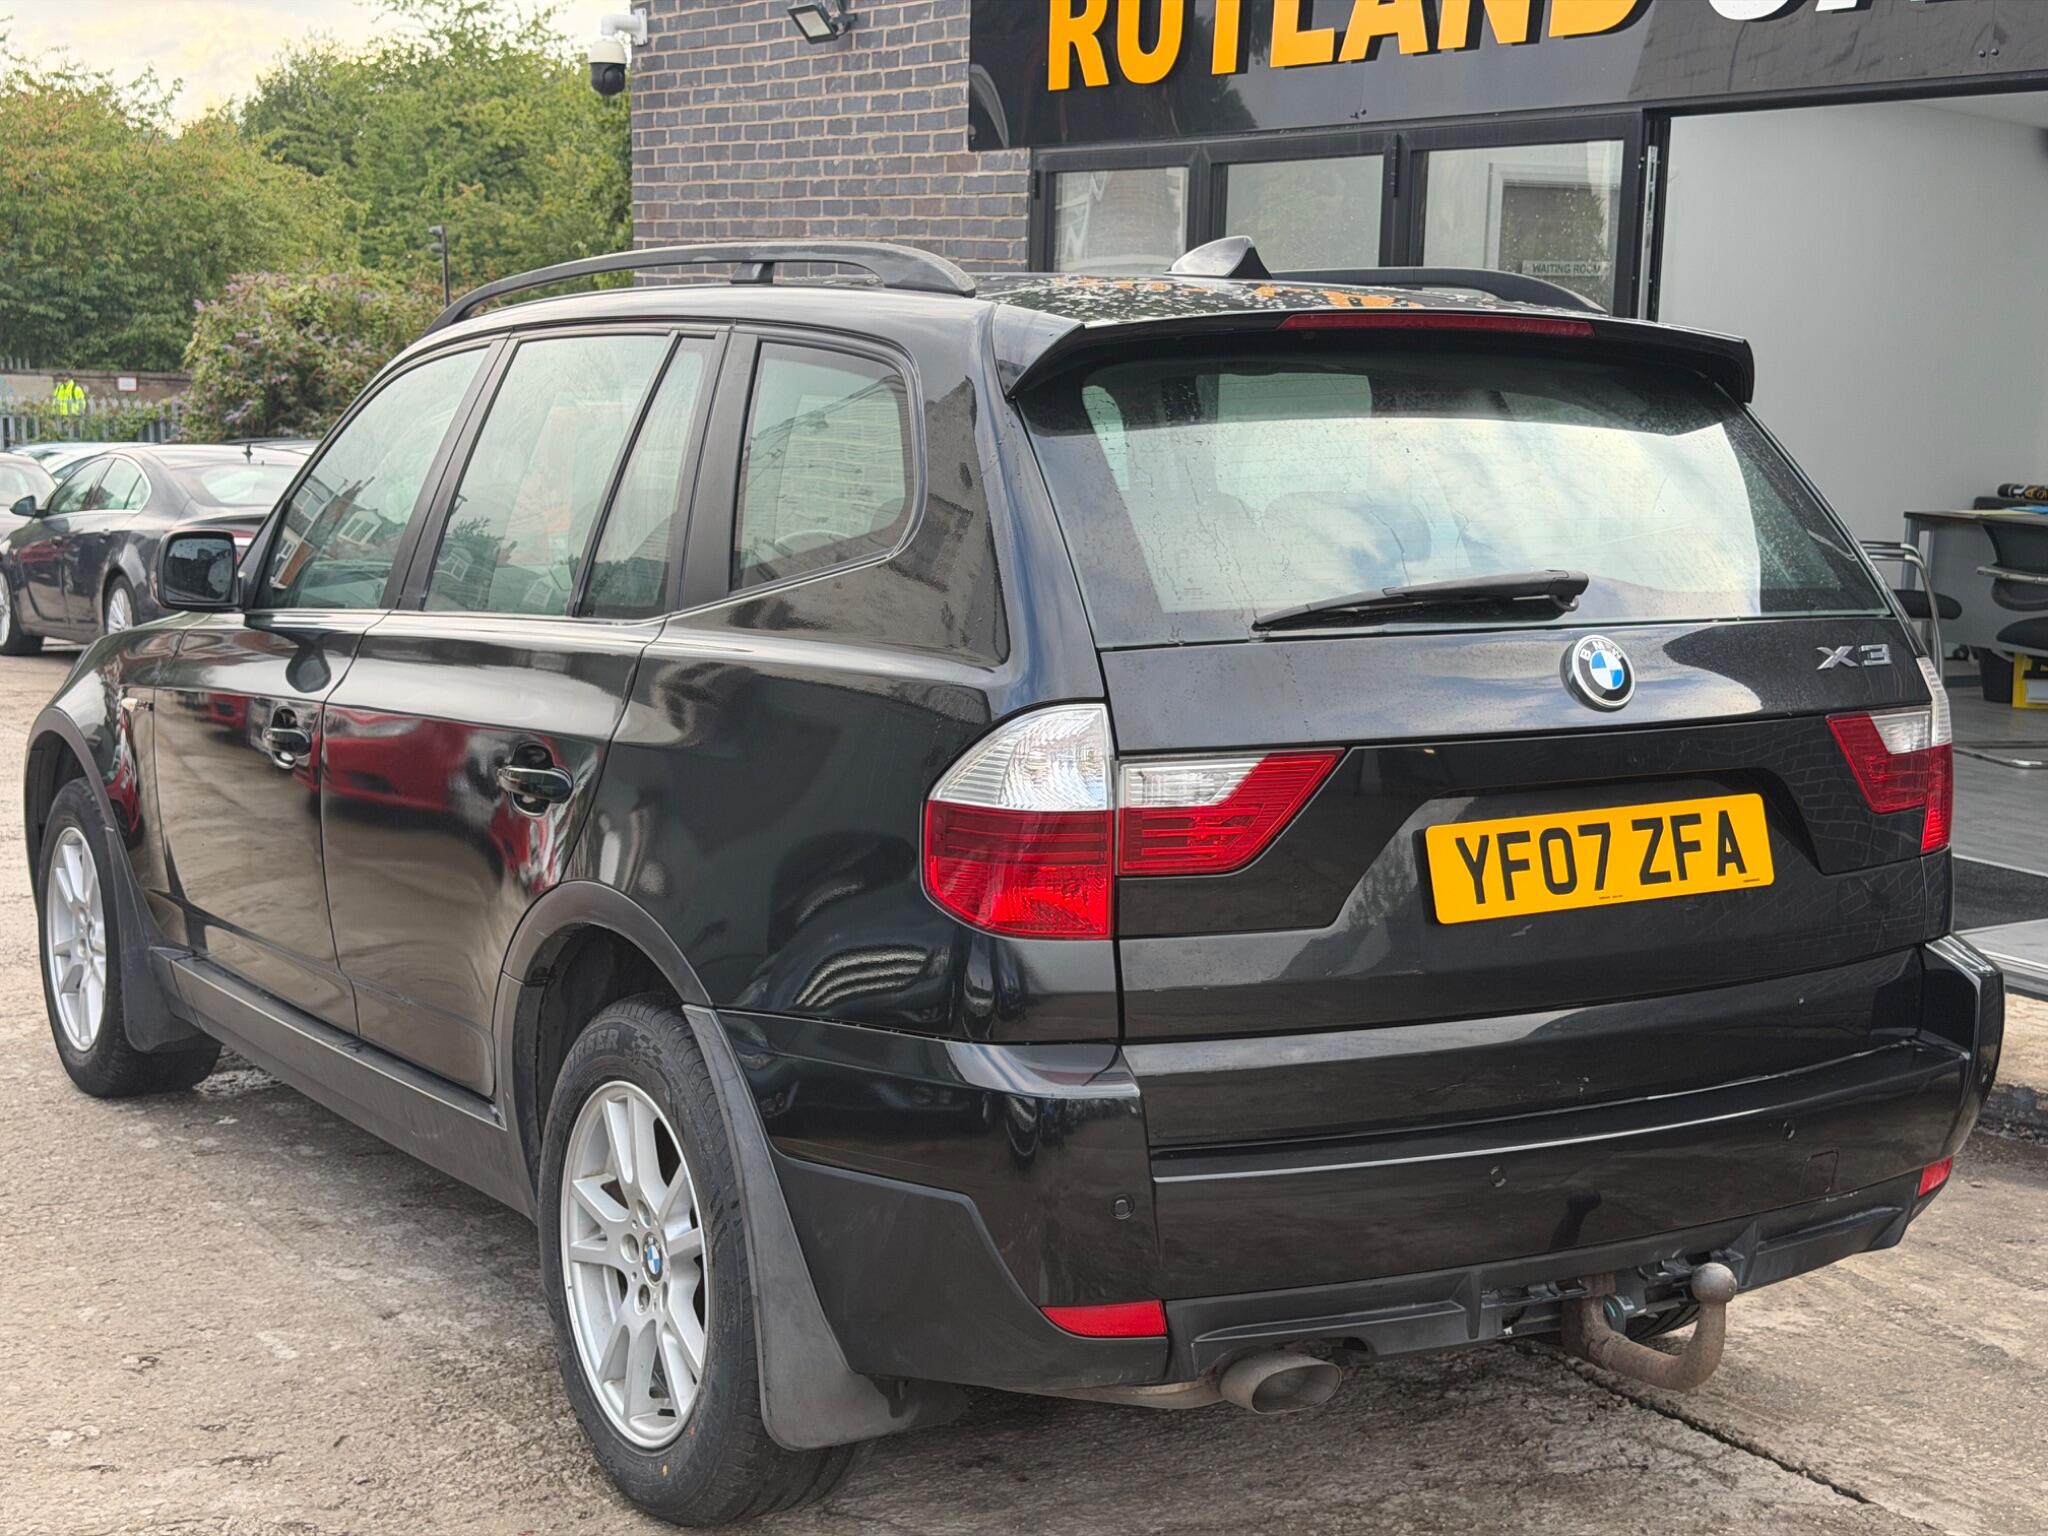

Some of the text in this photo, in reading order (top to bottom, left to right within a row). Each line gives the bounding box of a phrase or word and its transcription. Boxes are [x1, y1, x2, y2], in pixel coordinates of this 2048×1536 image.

[1532, 263, 1601, 274] WAITING ROOM
[1579, 640, 1623, 661] BMW
[1816, 643, 1893, 671] X3
[1455, 810, 1748, 906] YF07 ZFA
